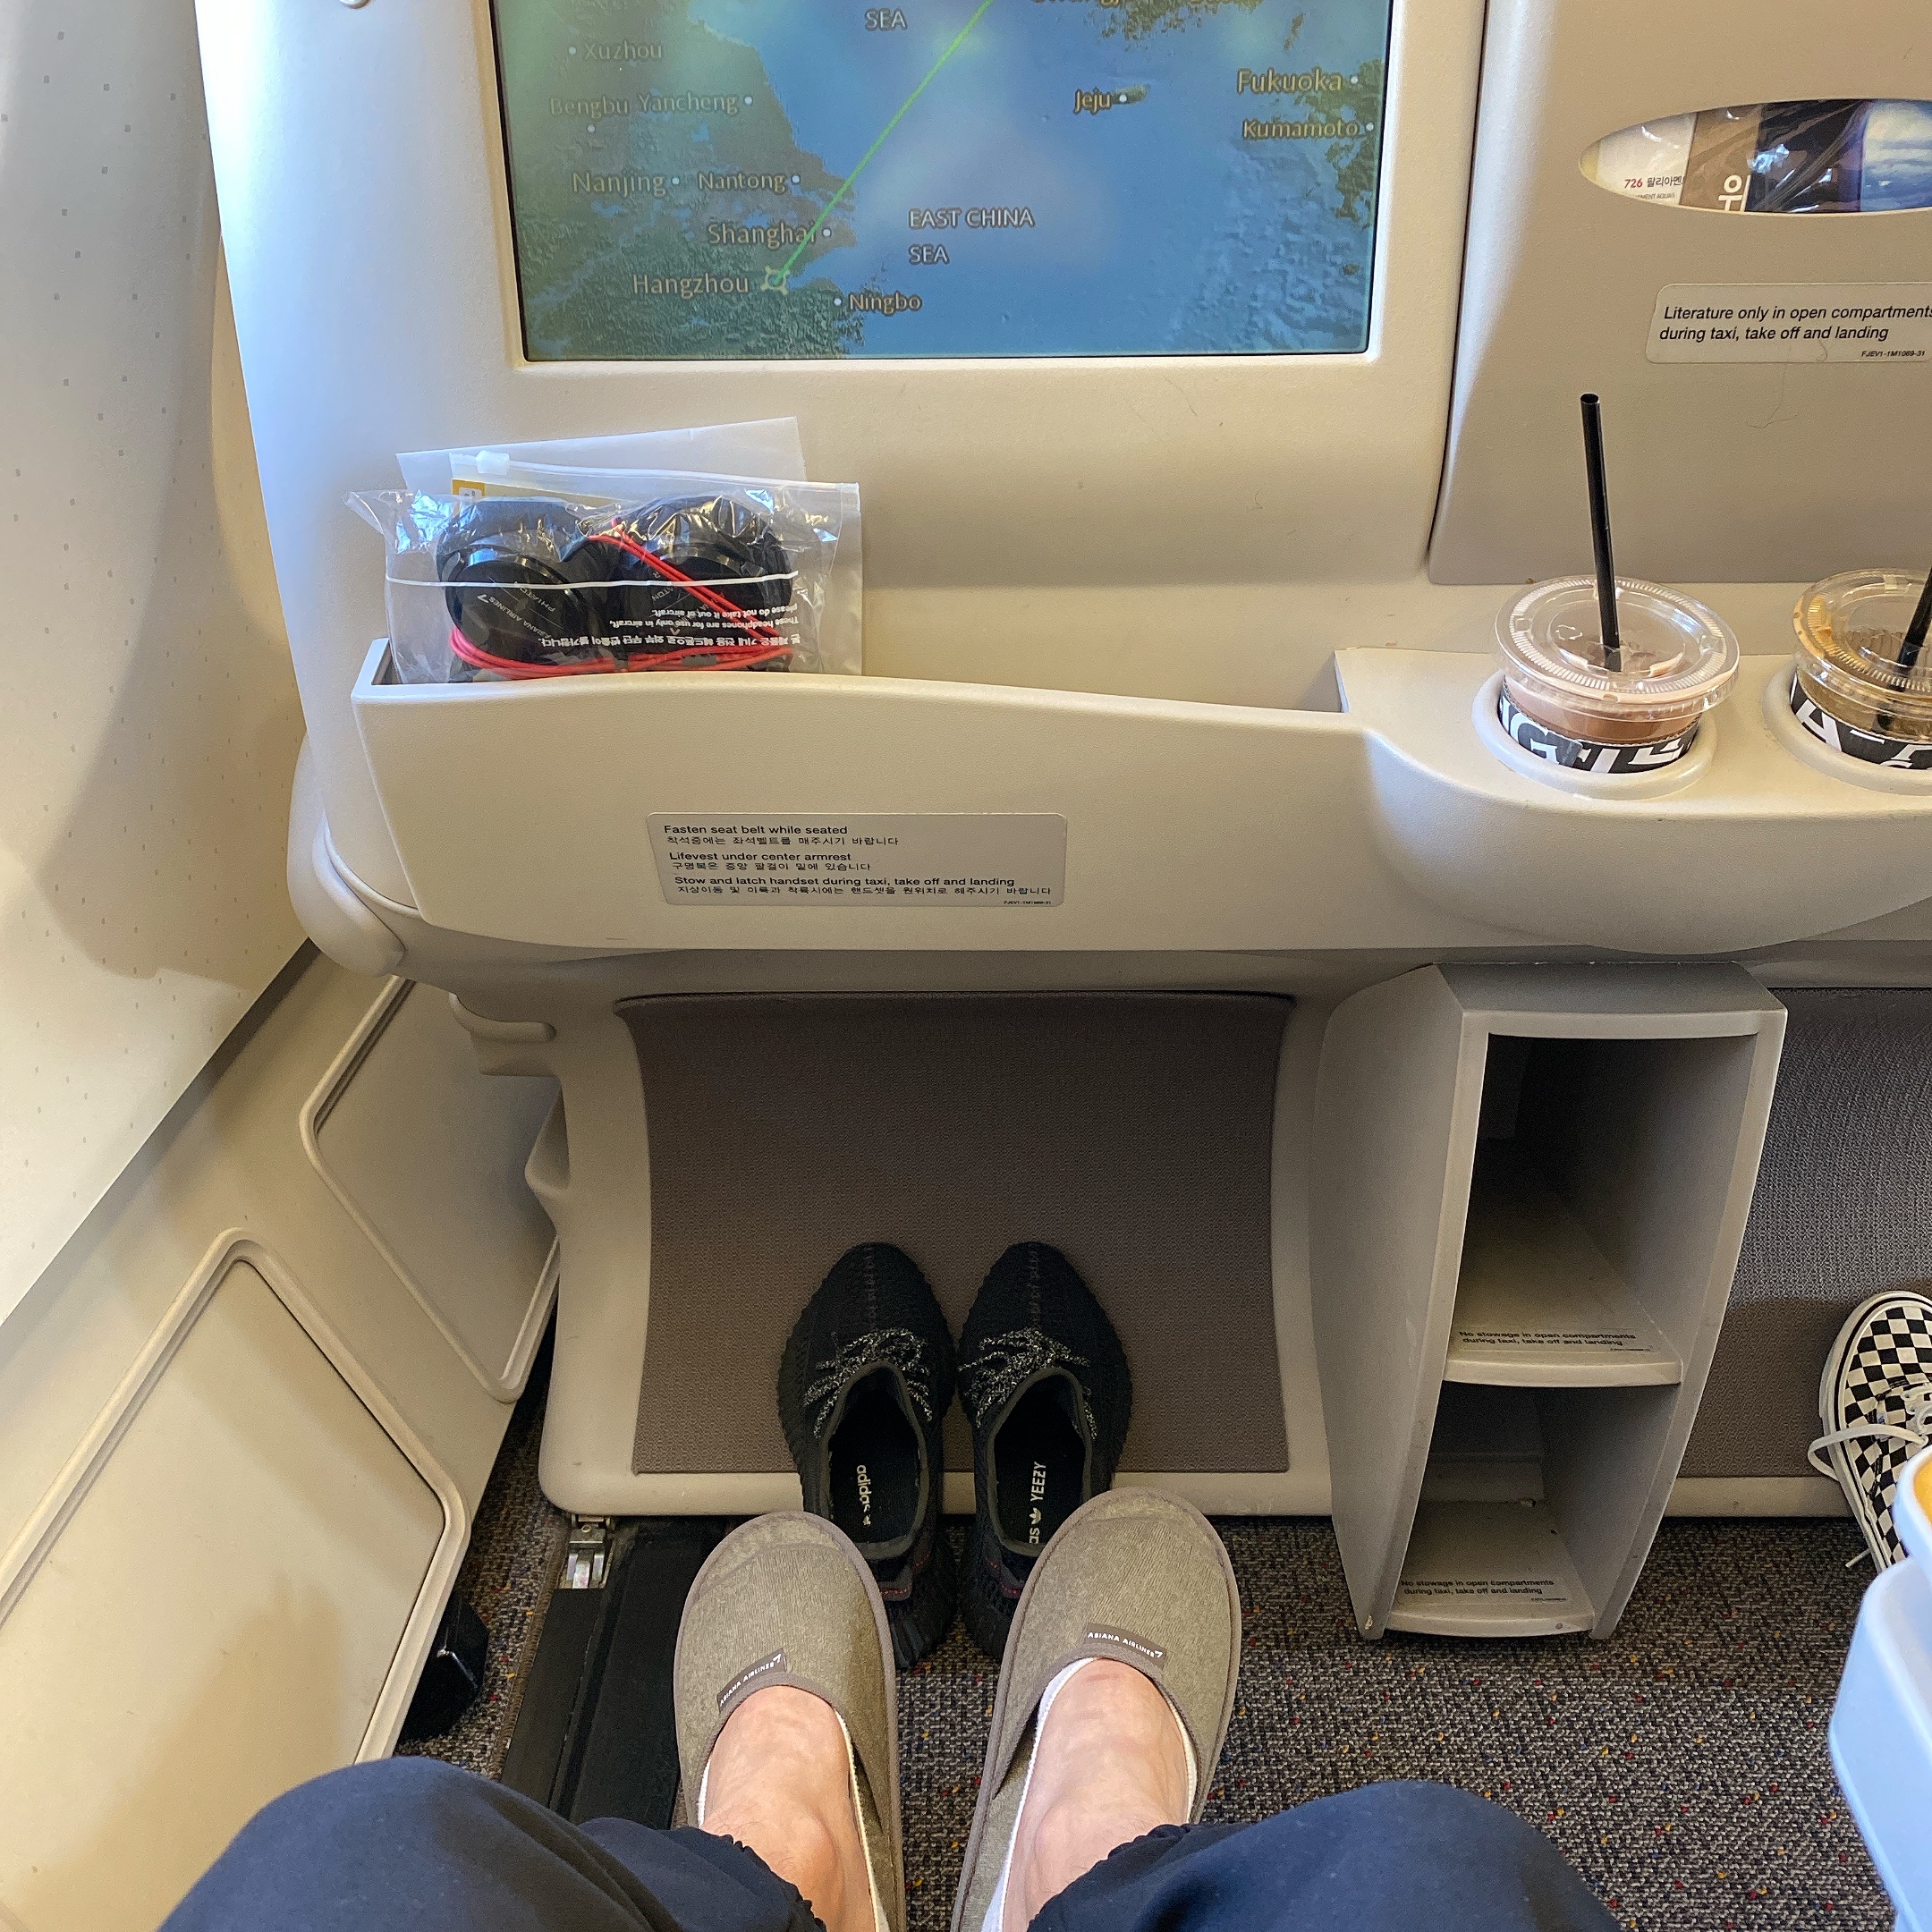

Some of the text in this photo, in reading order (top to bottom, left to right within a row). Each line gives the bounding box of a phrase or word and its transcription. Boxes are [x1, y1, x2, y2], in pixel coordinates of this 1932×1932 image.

[866, 10, 907, 30] SEA
[585, 41, 662, 60] Xuzhou
[1237, 68, 1342, 91] Fukuoka
[550, 96, 628, 119] Bengbu
[639, 92, 738, 114] Yancheng
[1074, 89, 1111, 114] Jeju
[1243, 119, 1359, 139] Kumamoto
[572, 173, 665, 197] Nanjing
[698, 172, 785, 193] Nantong
[1624, 175, 1684, 188] 726 팔리아멘
[910, 208, 1035, 227] EAST CHINA
[708, 222, 816, 250] Shanghai
[910, 245, 949, 263] SEA
[633, 272, 749, 300] Hangzhou
[850, 293, 921, 315] Ningbo
[1664, 306, 1733, 319] Literature
[1738, 306, 1768, 322] only
[1772, 306, 1785, 318] in
[1790, 308, 1826, 321] open
[1659, 326, 1889, 343] during taxi, take off and landing
[514, 581, 555, 612] PHIATO
[651, 609, 685, 618] aircraft.
[698, 610, 712, 618] out
[714, 611, 720, 619] it
[722, 610, 741, 619] take
[742, 609, 757, 618] not
[758, 609, 769, 617] do
[771, 603, 798, 614] please
[489, 597, 552, 639] ASIANA AIRLINES
[609, 619, 643, 628] aircraft,
[645, 619, 655, 627] in
[656, 619, 674, 628] only
[692, 621, 705, 629] for
[722, 620, 774, 630] headphones
[775, 615, 799, 625] These
[664, 826, 848, 835] Fasten seat belt while seated
[667, 836, 899, 846] 착석중에는 좌석벨트를 매주시기 바랍니다
[669, 852, 852, 861] Lifevest under center armrest
[674, 877, 1014, 887] Stow and latch handset during taxi, take off and landing
[857, 1464, 871, 1513] adidas
[1030, 1461, 1046, 1501] YEEZY
[1088, 1632, 1155, 1657] ASIANA AIRLINES
[719, 1661, 775, 1707] ASIANA AIRLINES
